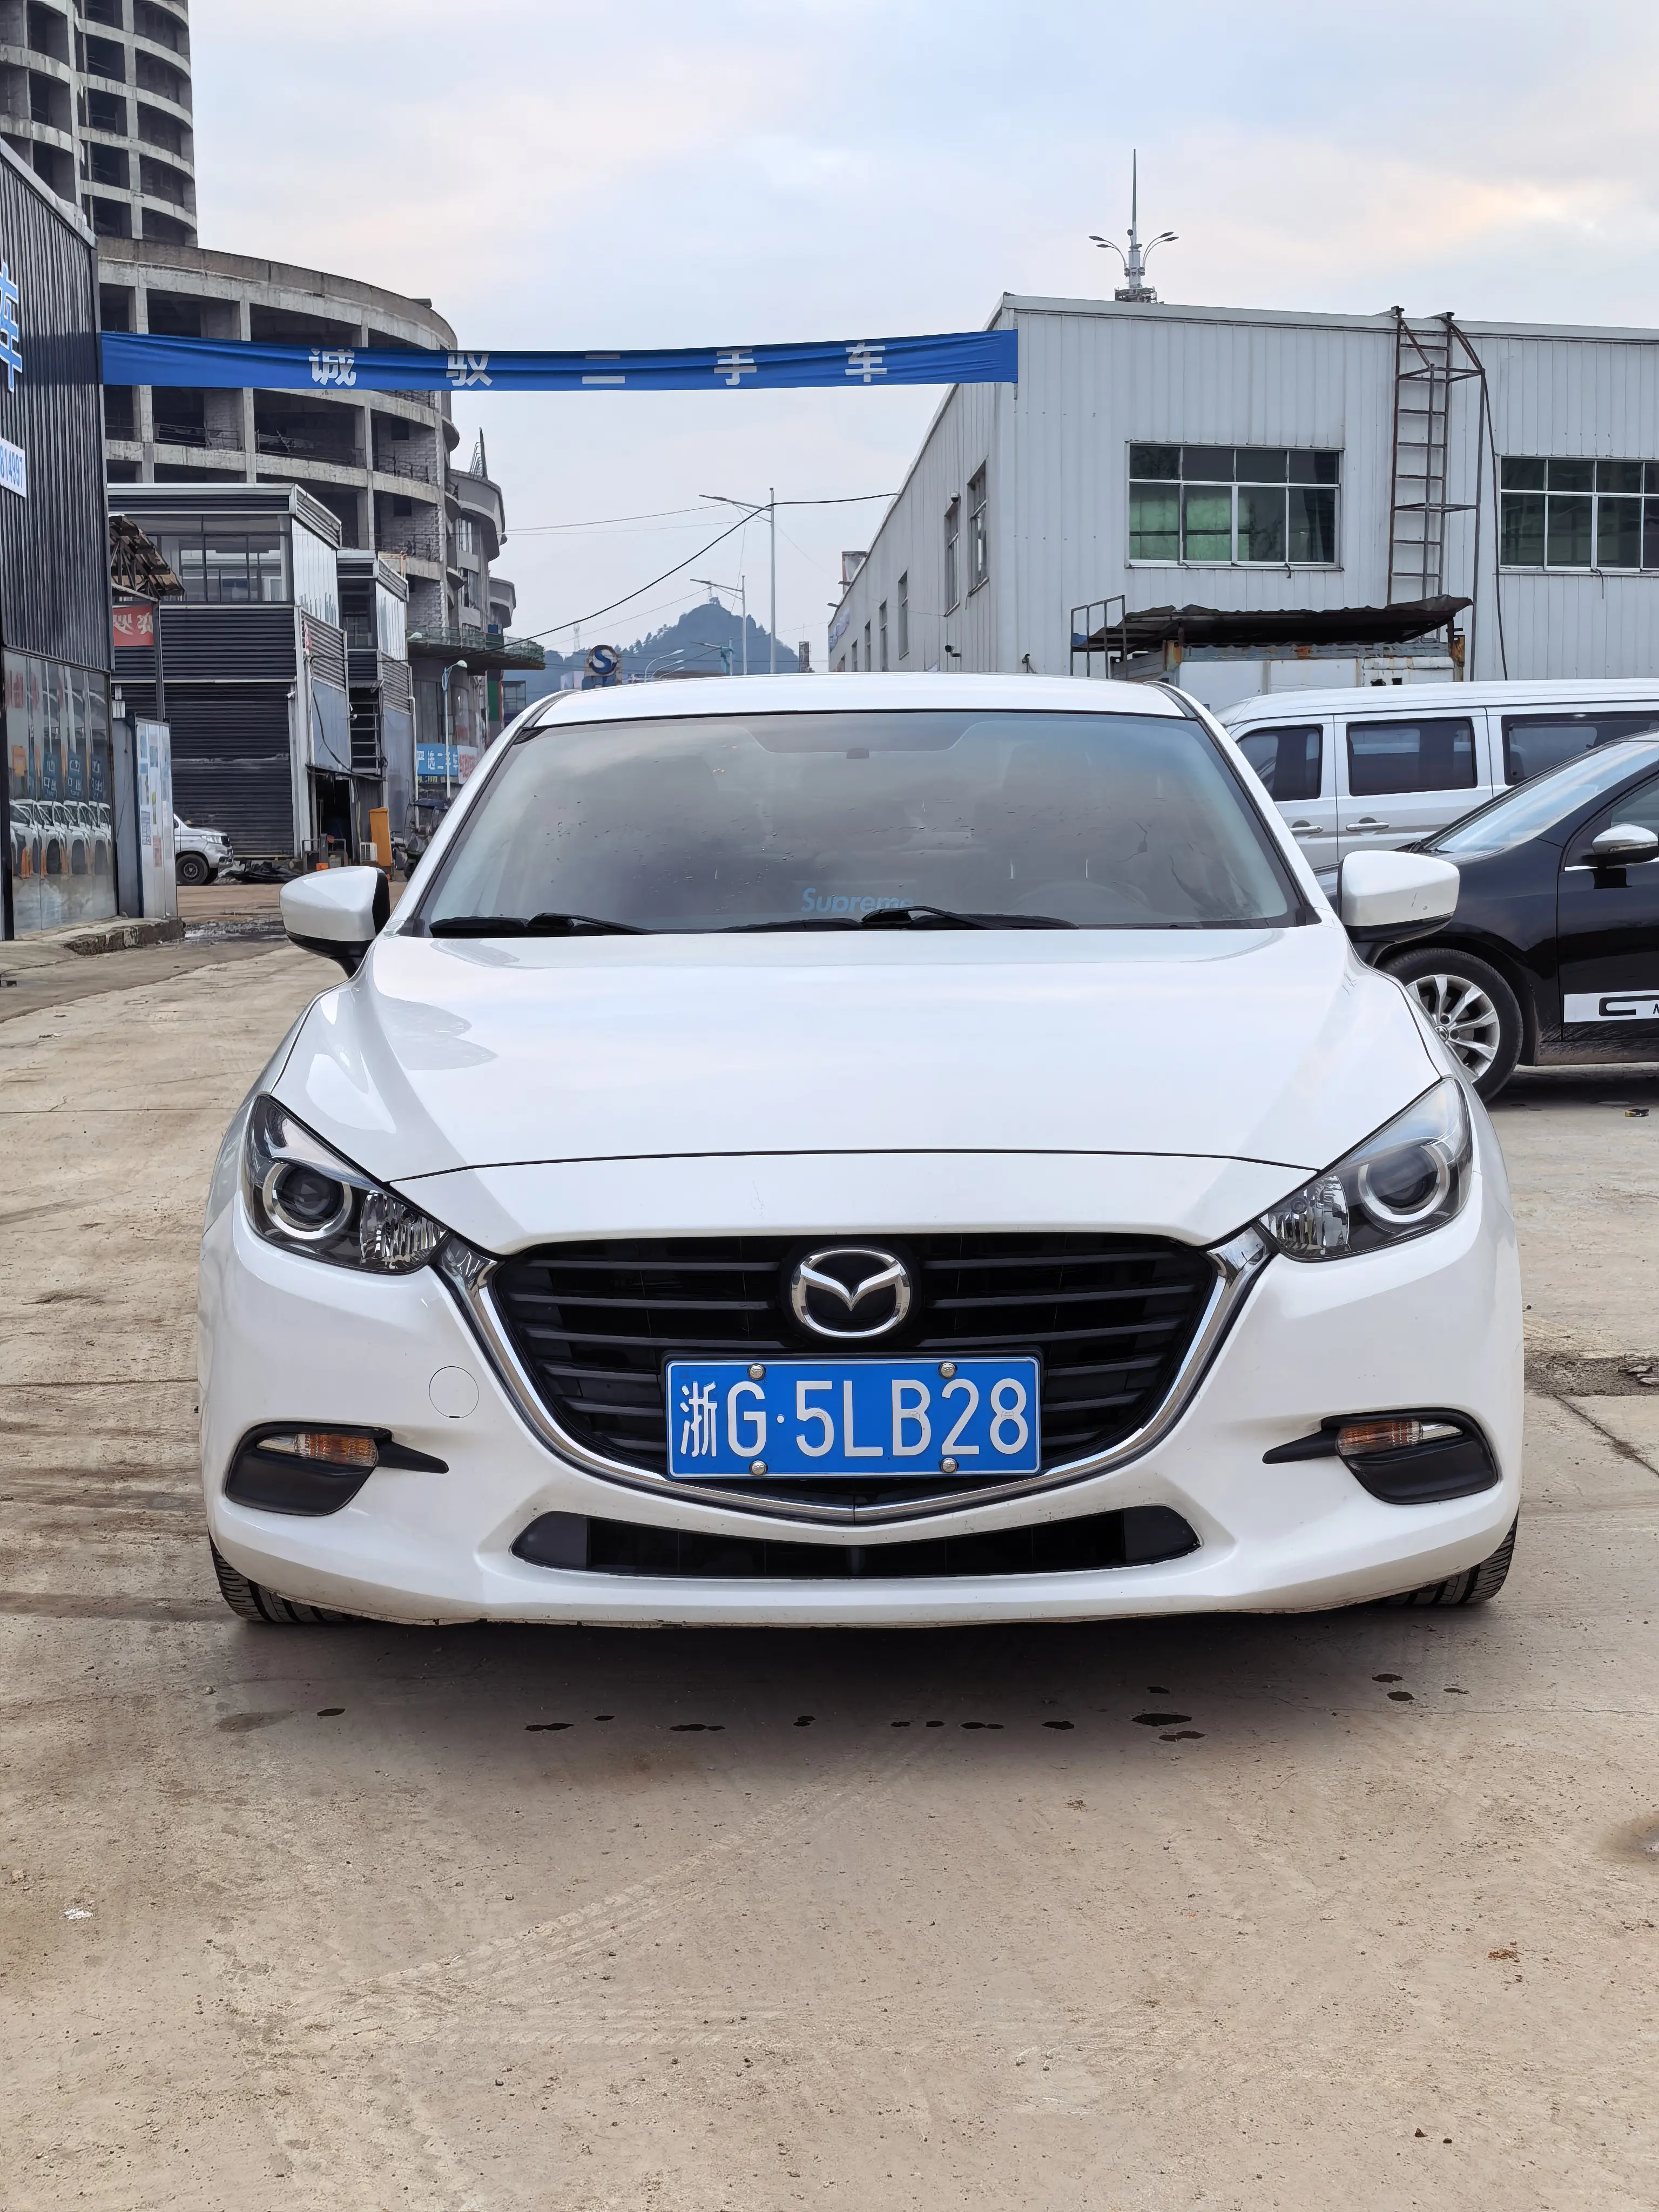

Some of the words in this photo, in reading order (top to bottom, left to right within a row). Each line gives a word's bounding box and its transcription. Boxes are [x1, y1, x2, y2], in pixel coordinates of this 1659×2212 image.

[309, 342, 887, 386] 诚驭二手车
